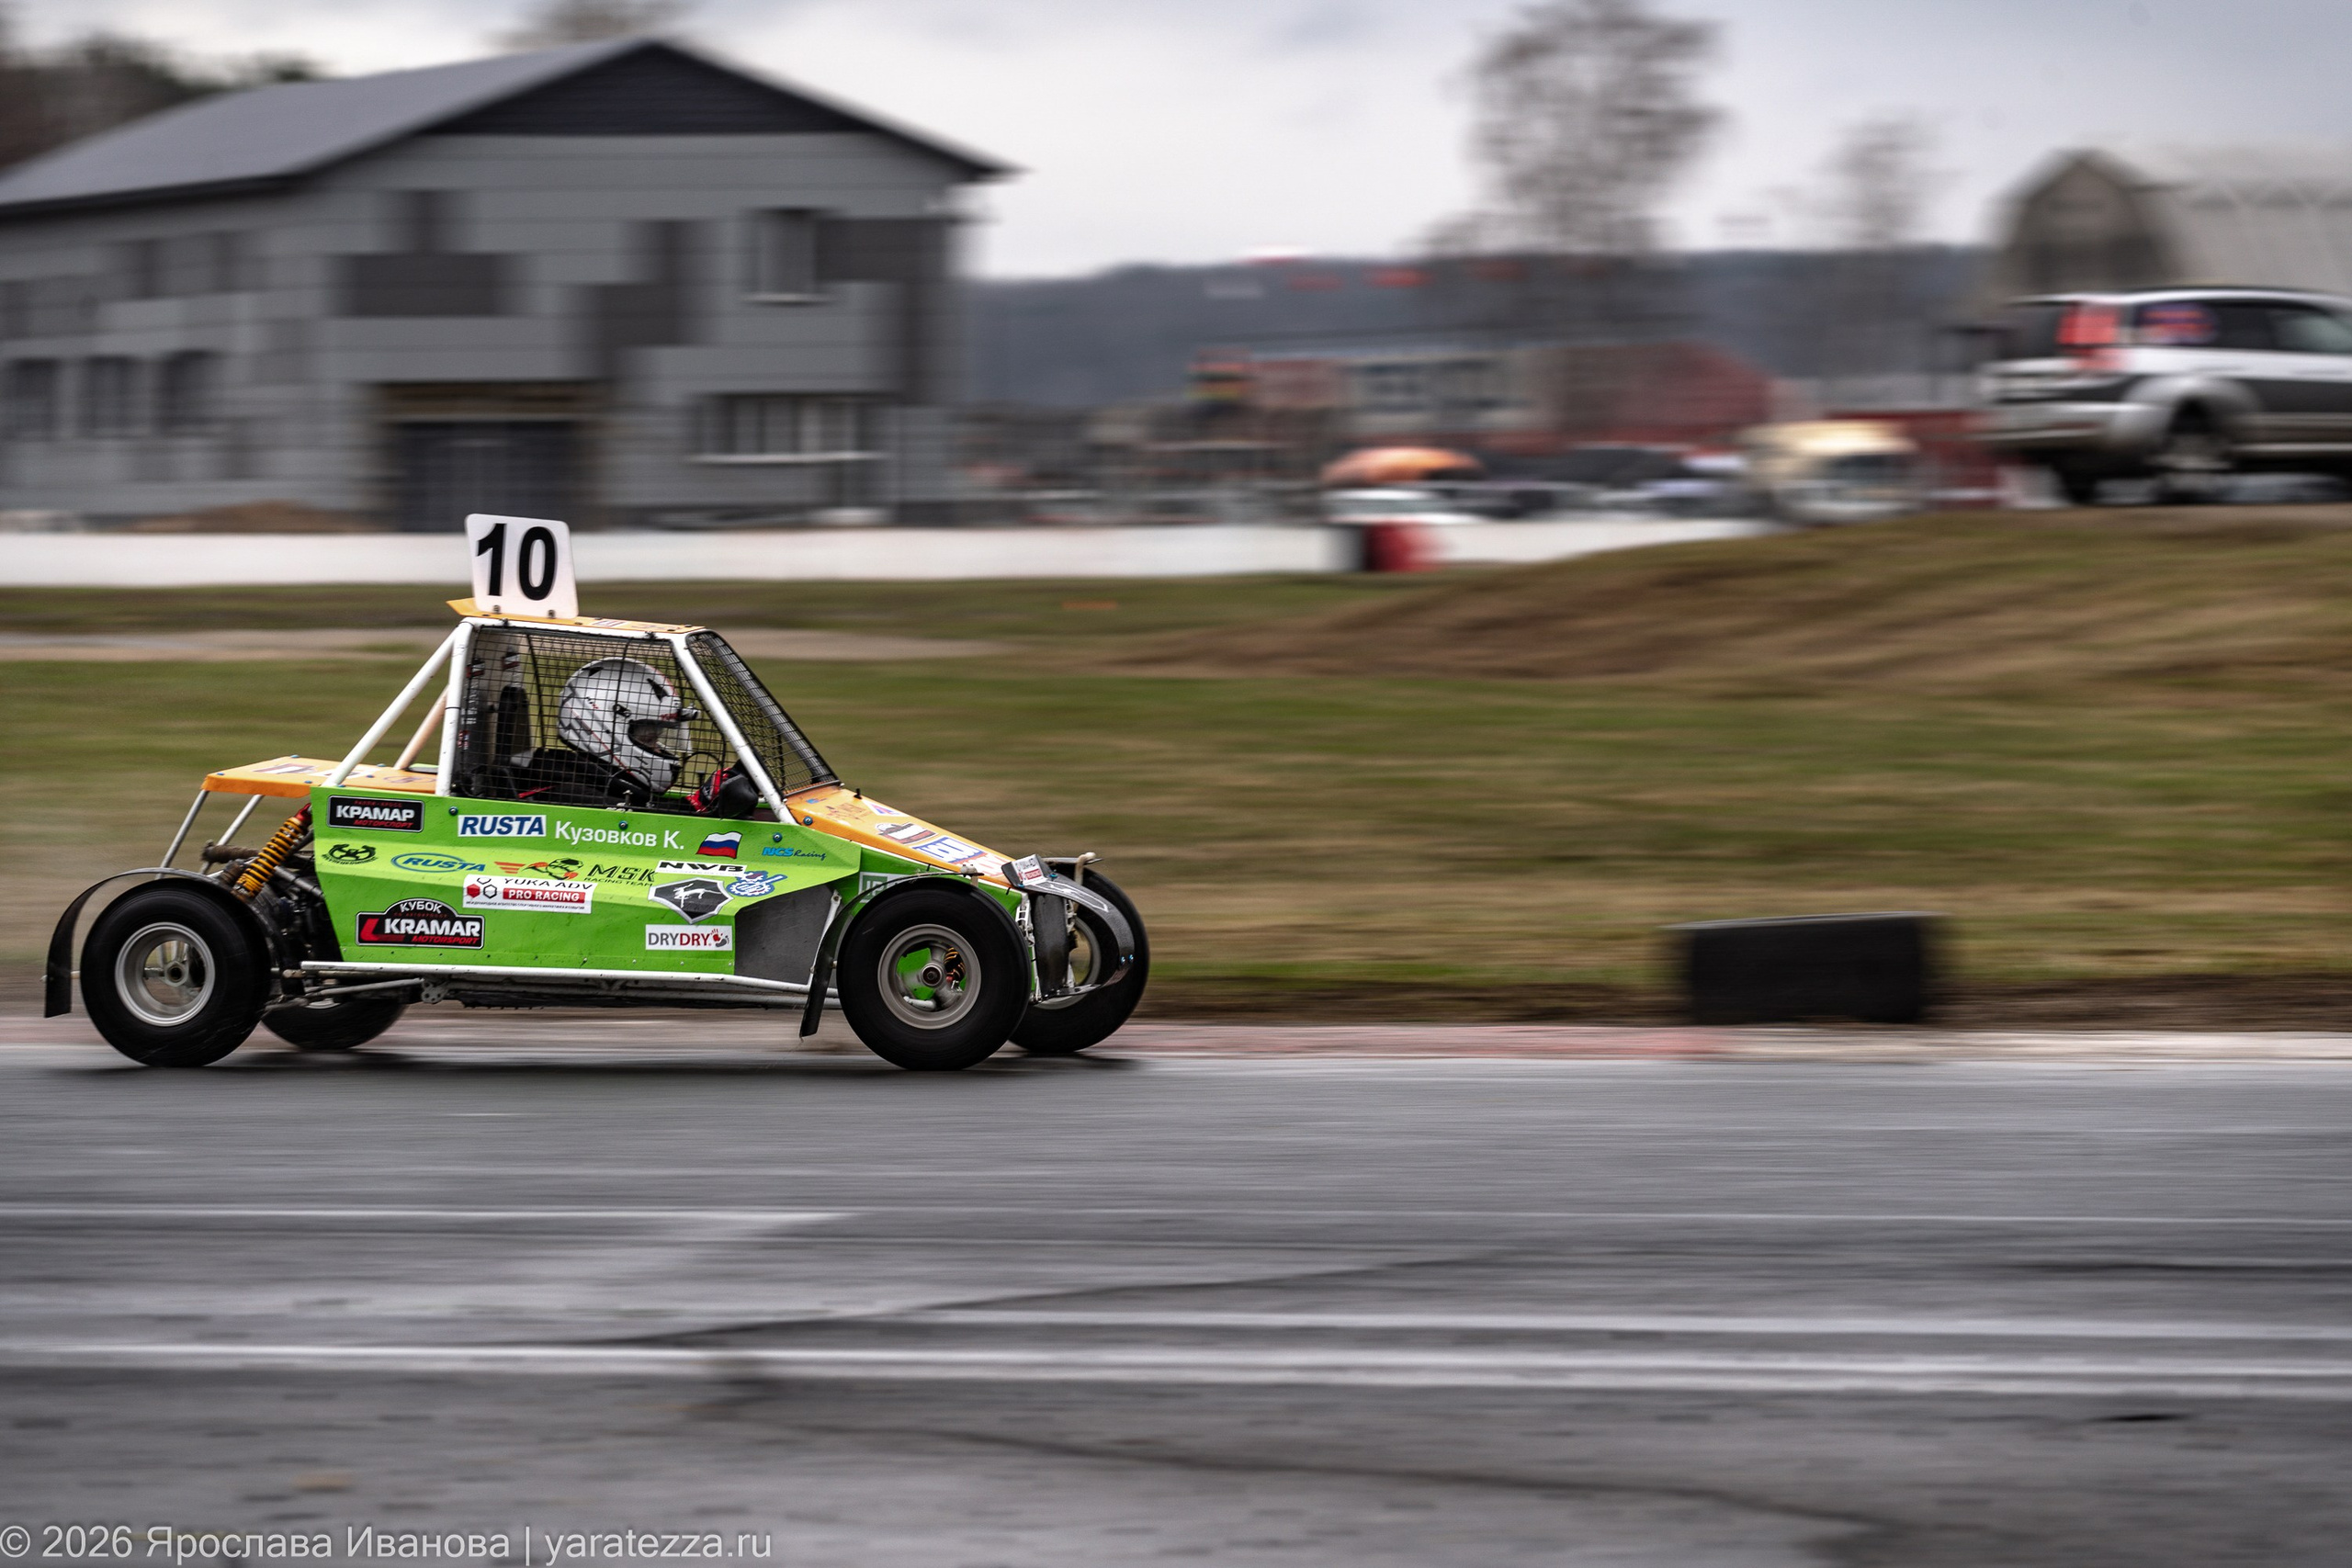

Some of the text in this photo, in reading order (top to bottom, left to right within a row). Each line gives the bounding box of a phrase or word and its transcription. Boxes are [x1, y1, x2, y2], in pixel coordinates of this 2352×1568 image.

[476, 523, 558, 601] 10
[335, 805, 415, 821] КРАМАР
[353, 819, 414, 829] МОТОРСПОРТ
[460, 816, 545, 835] RUSTA
[555, 820, 685, 850] Кузовков К.
[762, 847, 827, 861] NCS Racing
[402, 857, 486, 872] RUSTA
[659, 862, 744, 872] NWB
[587, 864, 657, 882] MSK
[504, 878, 594, 890] YUKA ADV
[508, 889, 580, 902] PRO RACING
[400, 900, 443, 914] КУБОК
[384, 919, 481, 937] KRAMAR
[411, 935, 480, 944] MOTORSPORT
